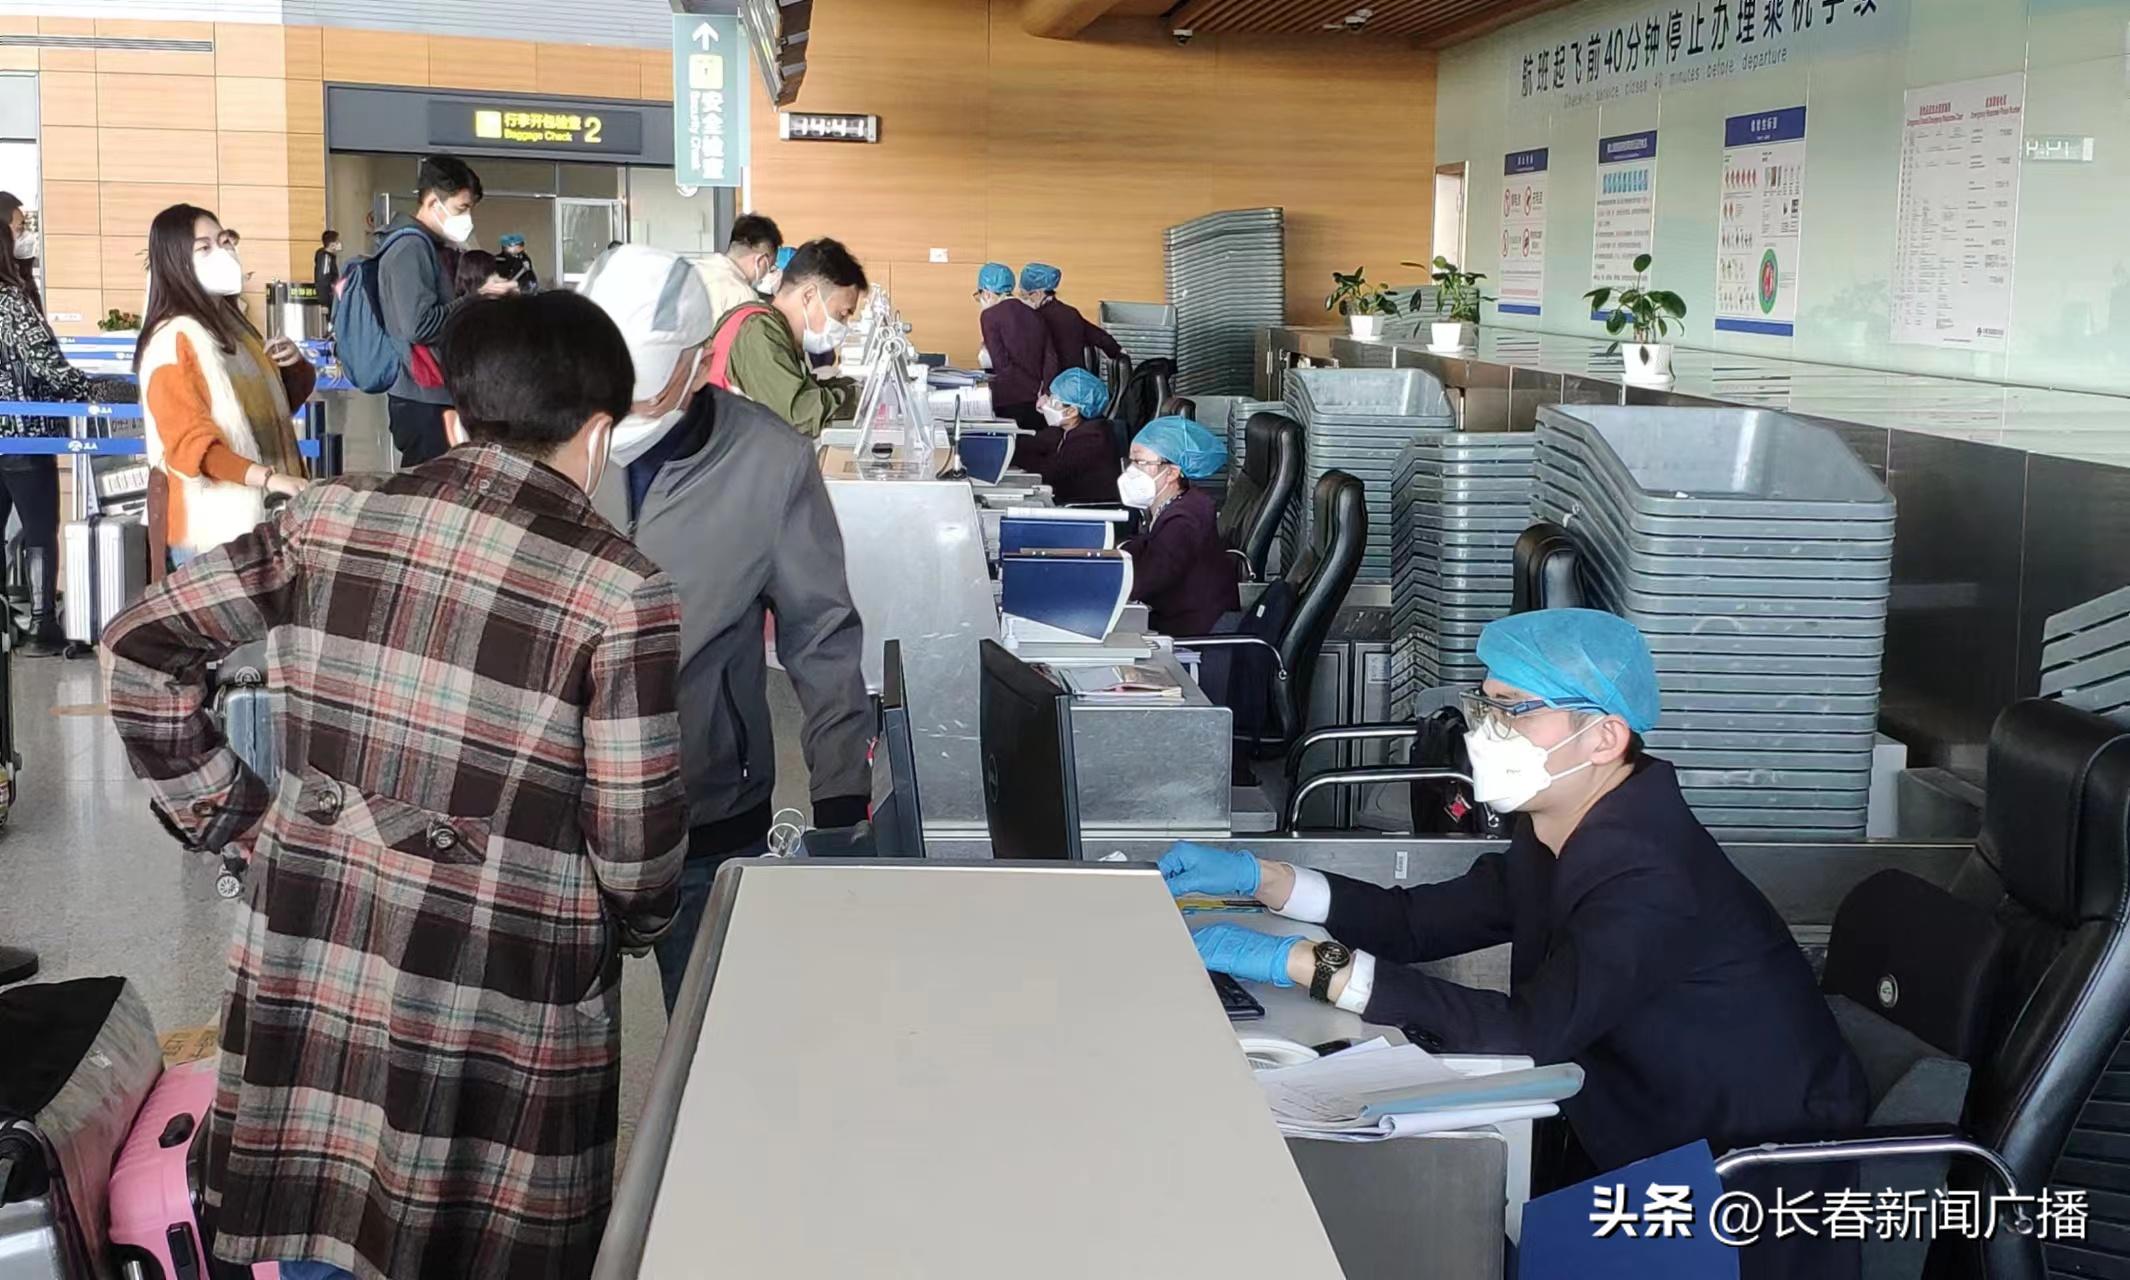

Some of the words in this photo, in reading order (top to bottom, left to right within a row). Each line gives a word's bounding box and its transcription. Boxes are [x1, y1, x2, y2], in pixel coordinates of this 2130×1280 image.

[1742, 47, 1788, 71] departure
[544, 130, 573, 142] Check
[584, 116, 602, 143] 2
